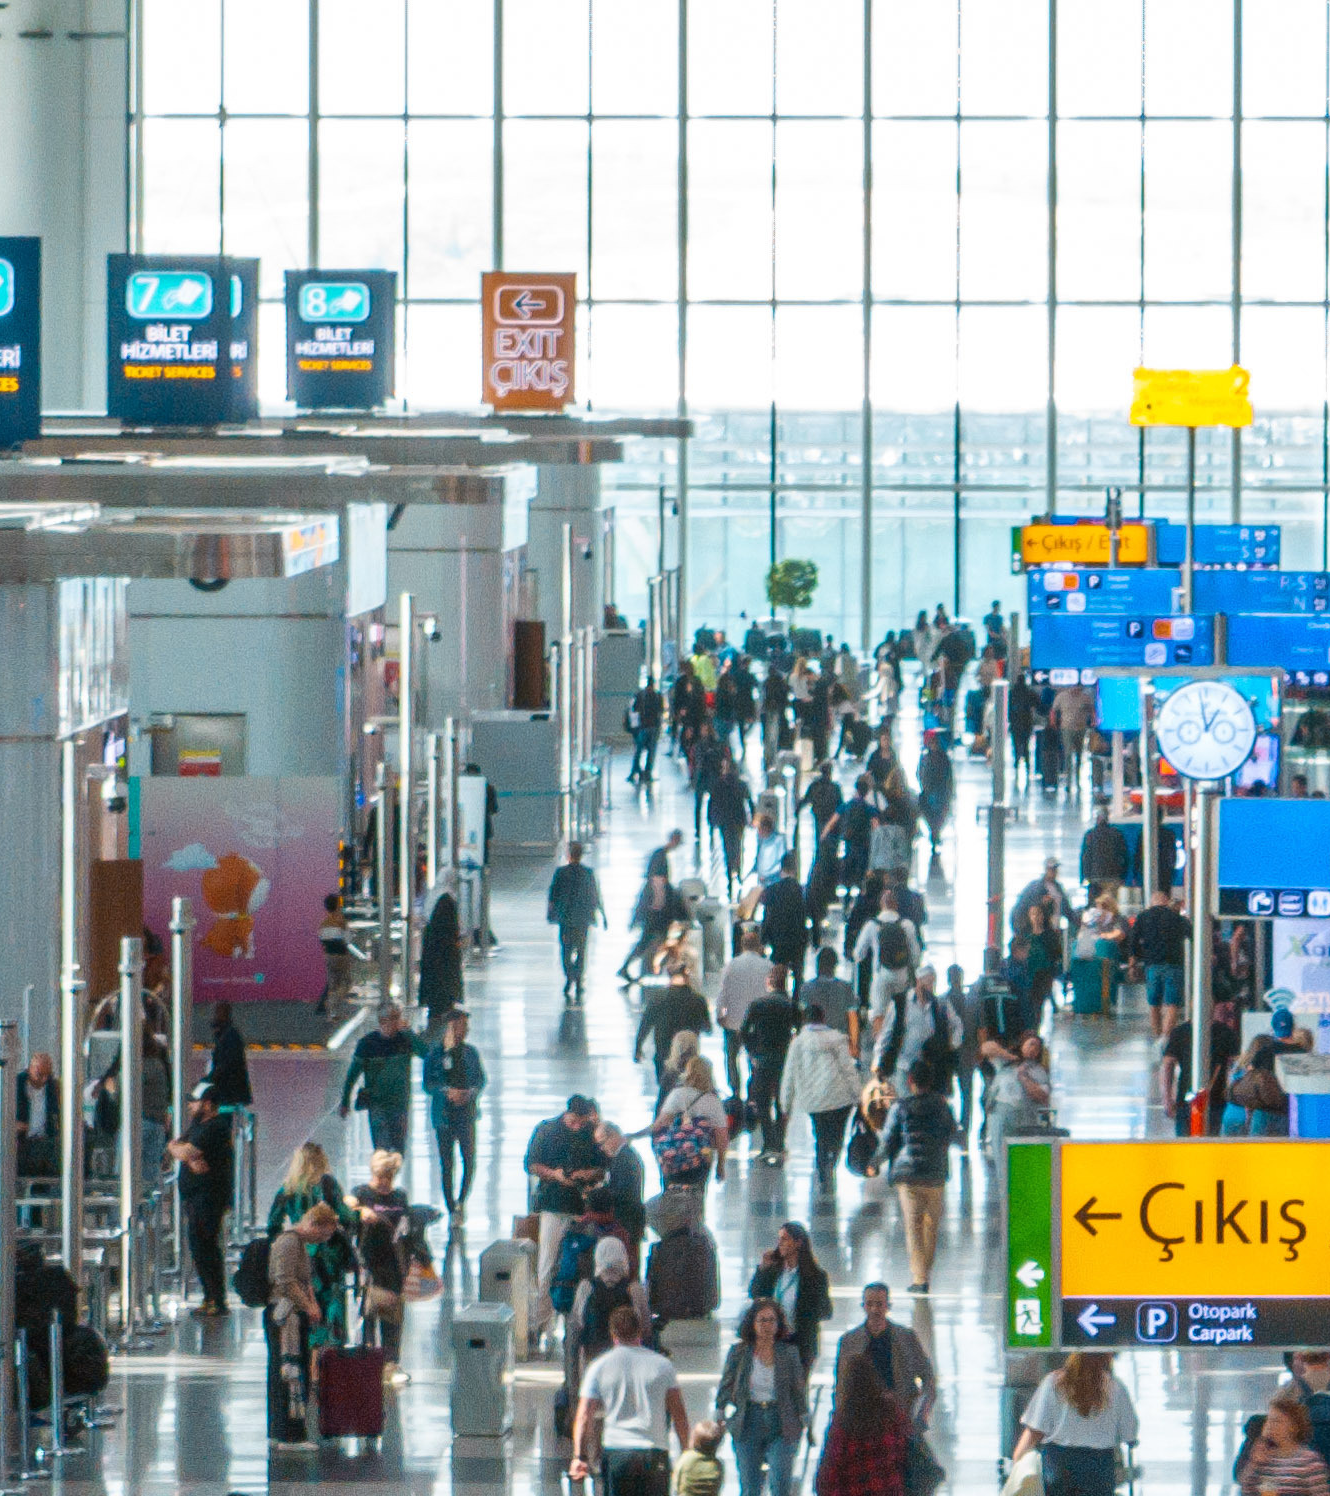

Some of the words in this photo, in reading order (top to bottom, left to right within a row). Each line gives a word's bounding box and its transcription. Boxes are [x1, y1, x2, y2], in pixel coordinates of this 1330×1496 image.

[134, 276, 160, 312] 7
[306, 287, 327, 317] 8
[144, 324, 193, 342] BİLET
[493, 328, 565, 358] EXIT
[120, 341, 219, 360] HİZMETLERİ
[123, 366, 163, 379] TICKET
[164, 366, 217, 379] SERVICES
[490, 360, 569, 398] ÇIKIŞ
[1041, 533, 1082, 554] Çıkış
[1139, 1180, 1308, 1262] Çıkış
[1147, 1307, 1168, 1337] P
[1187, 1302, 1257, 1323] Otopark
[1187, 1325, 1254, 1345] Carpark
